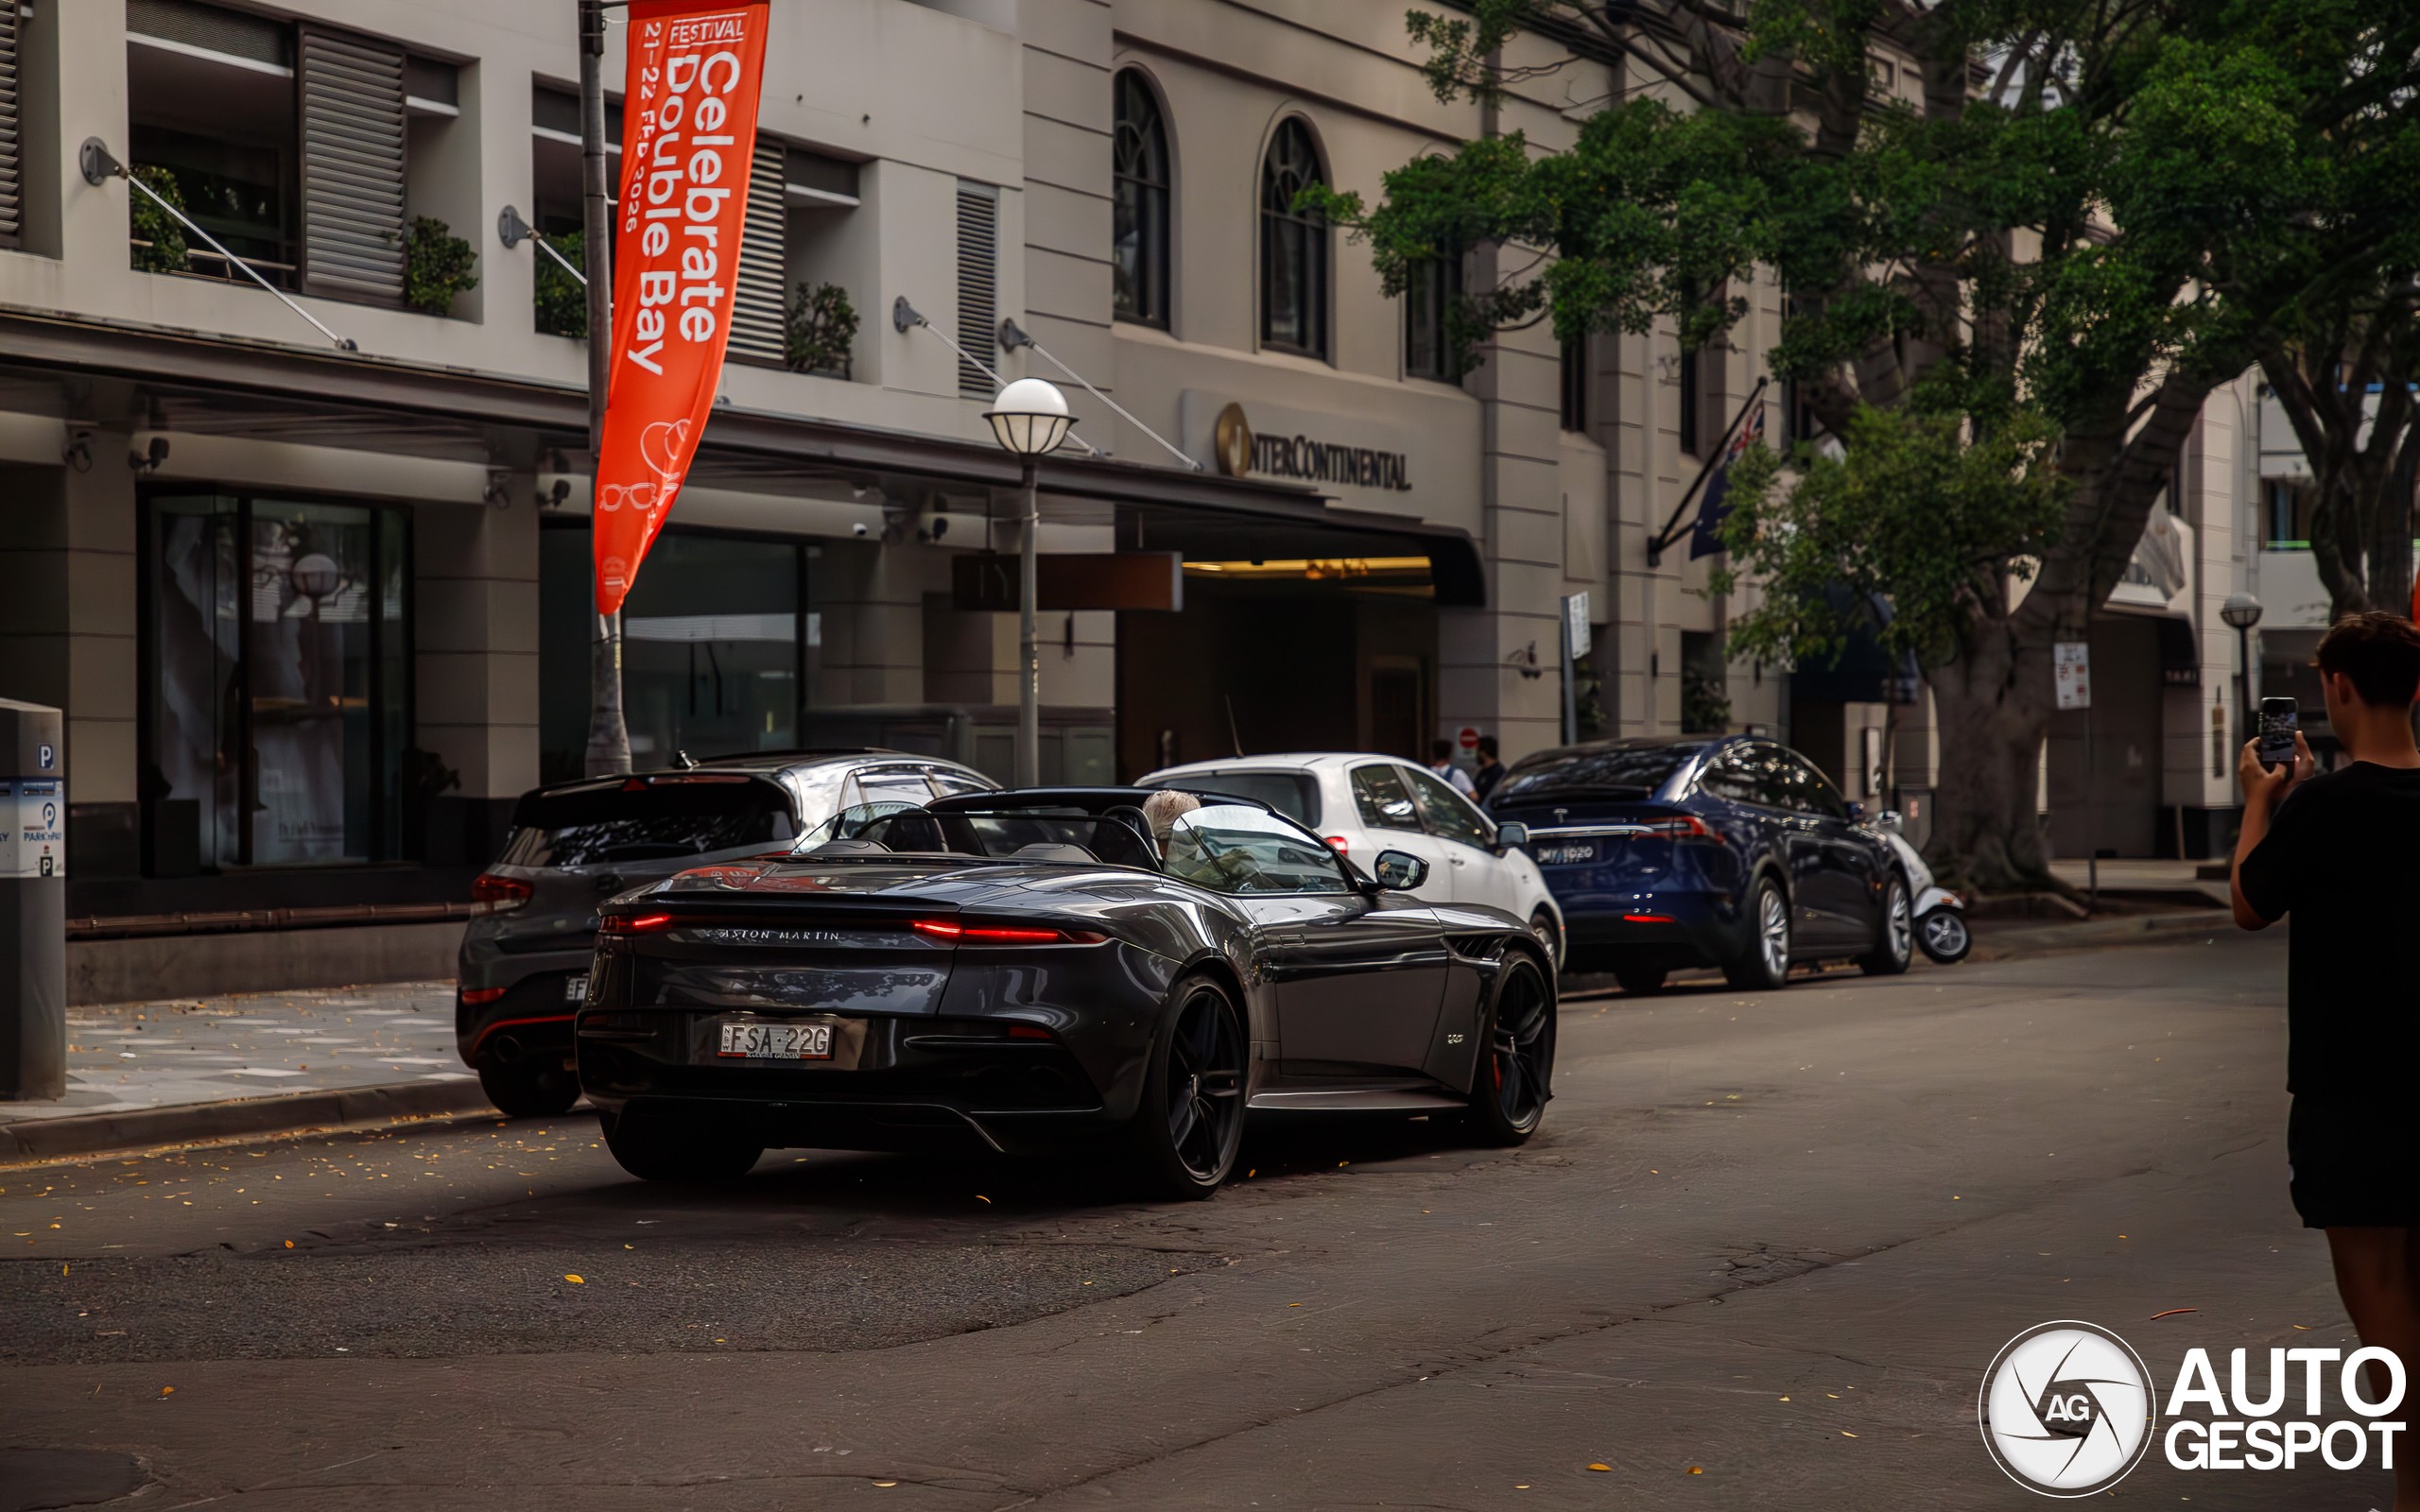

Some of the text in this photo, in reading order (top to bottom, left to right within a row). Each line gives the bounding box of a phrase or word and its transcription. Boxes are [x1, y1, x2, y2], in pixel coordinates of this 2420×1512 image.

[669, 19, 745, 43] FESTIVAL
[625, 164, 646, 233] 2026
[679, 50, 740, 343] Celebrate
[627, 54, 701, 376] Double Bay
[40, 745, 52, 768] P
[721, 929, 840, 941] ASTON MARTIN
[722, 1027, 731, 1051] NSW
